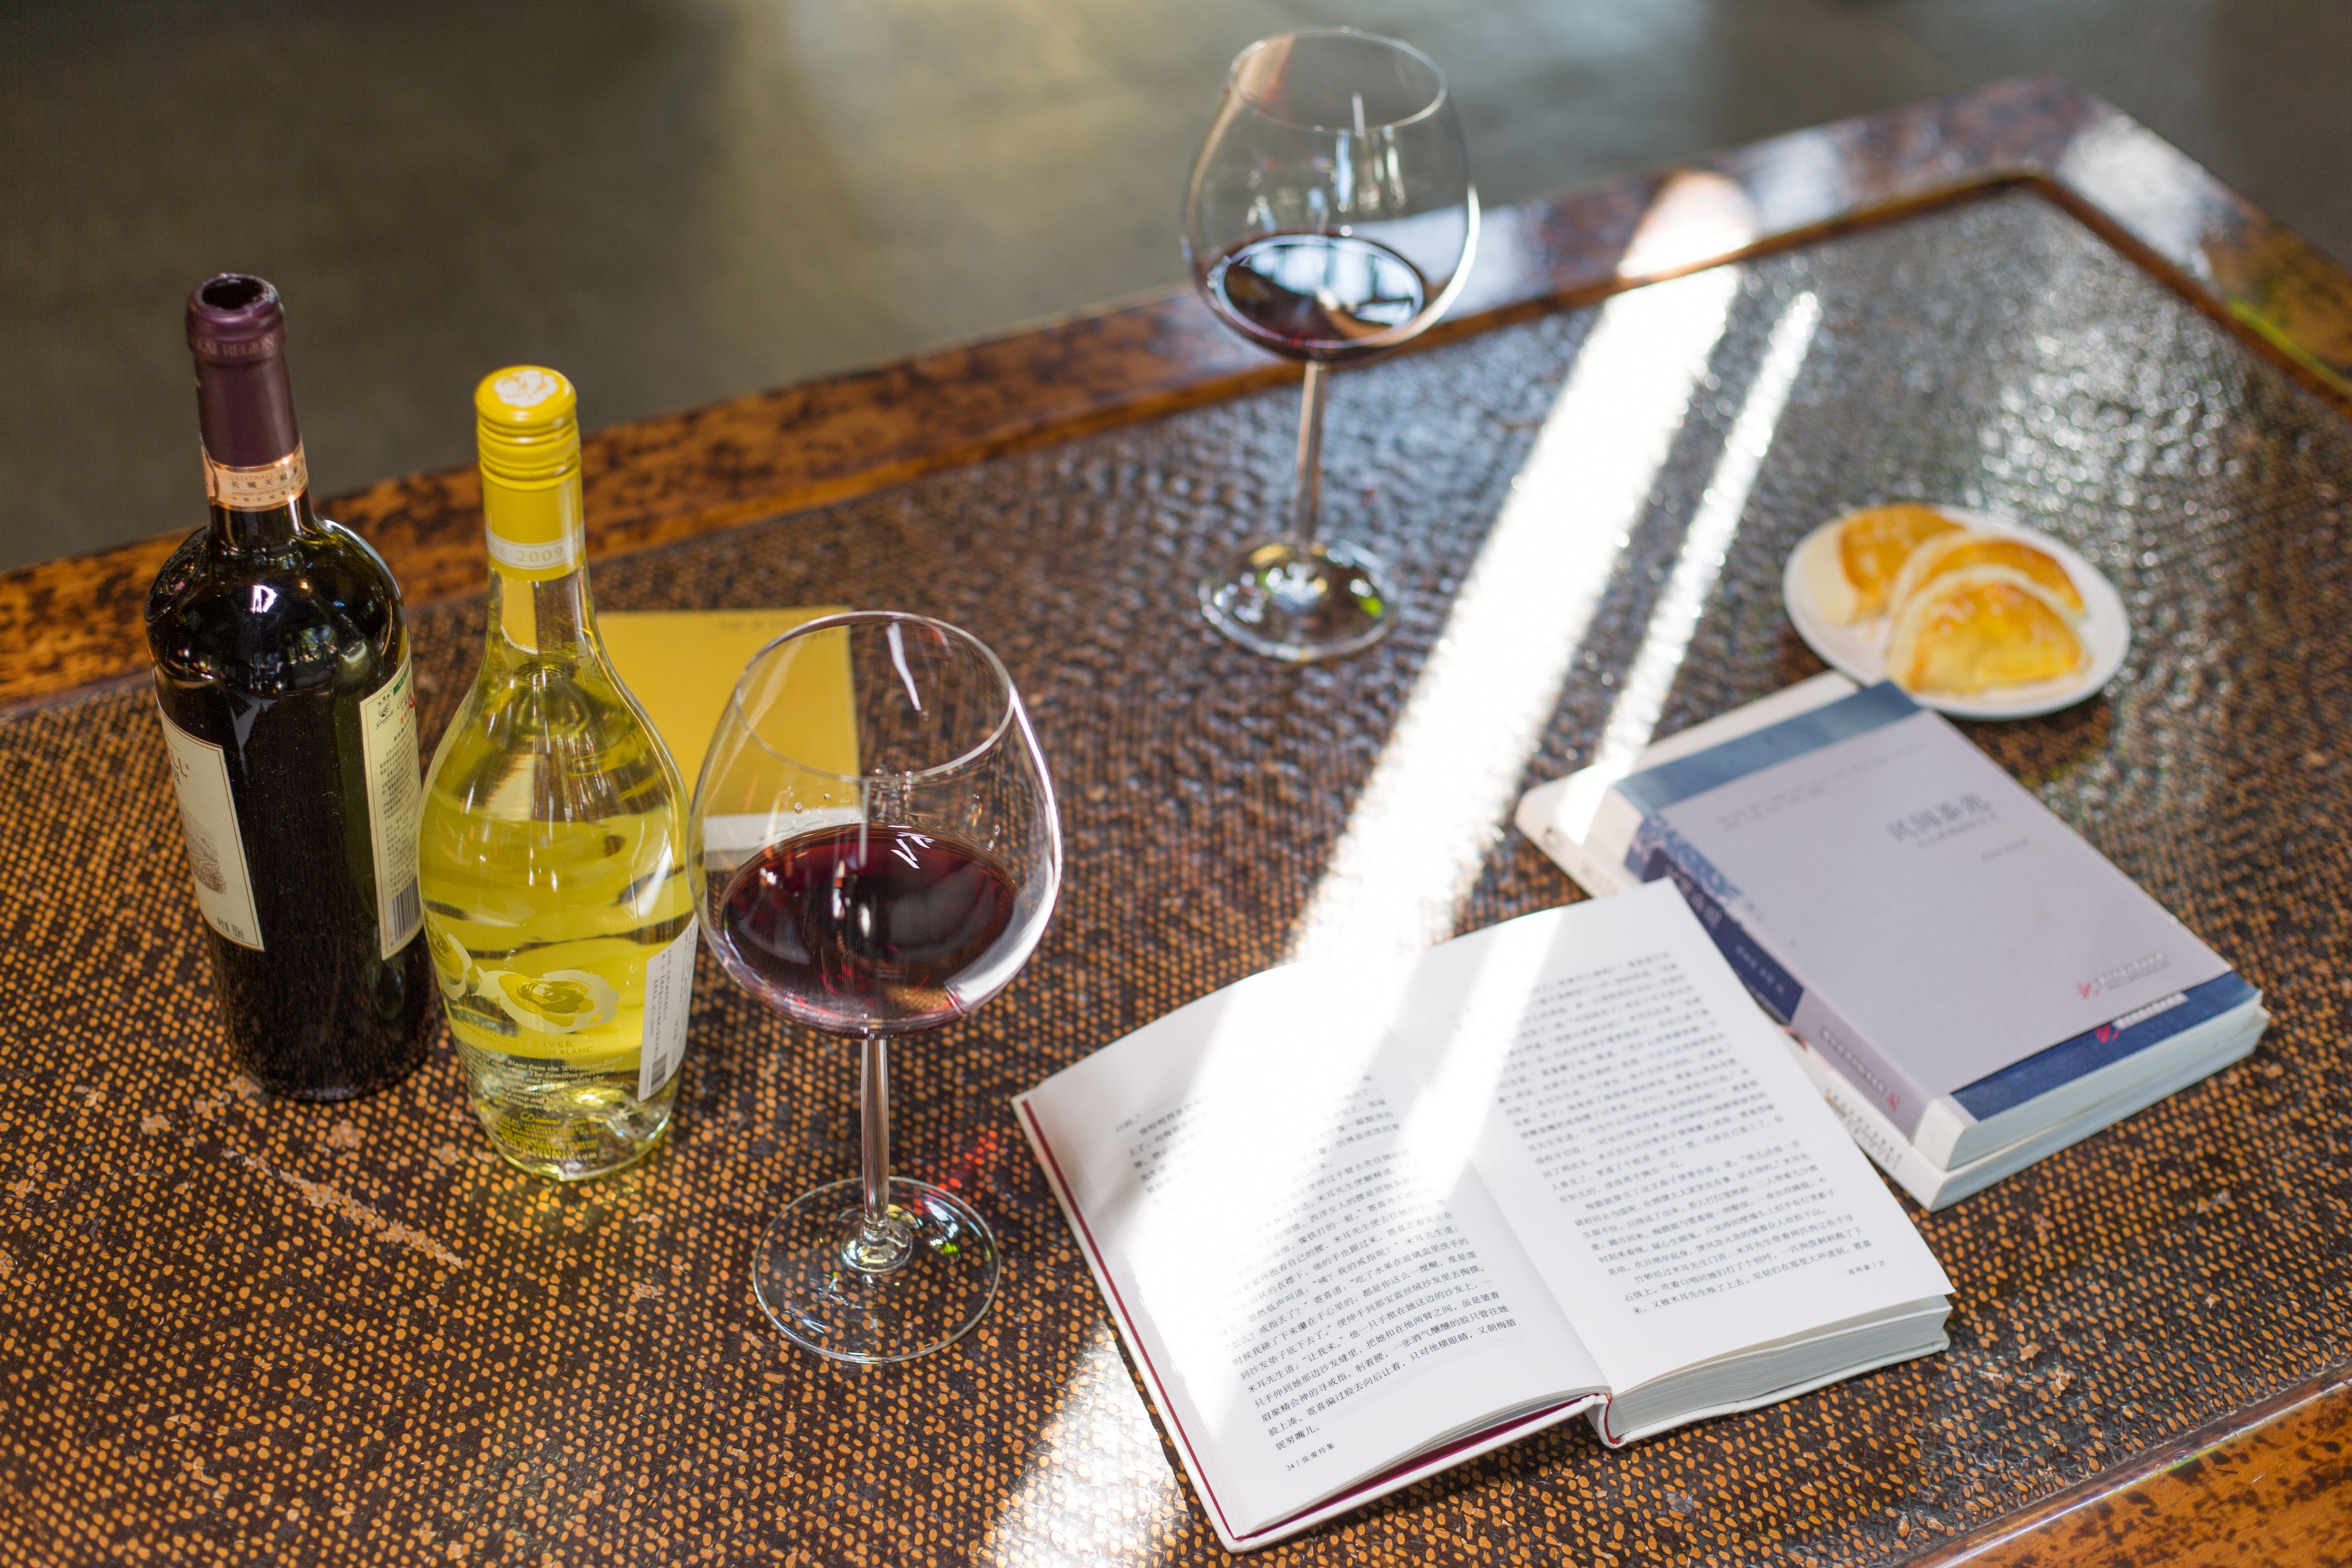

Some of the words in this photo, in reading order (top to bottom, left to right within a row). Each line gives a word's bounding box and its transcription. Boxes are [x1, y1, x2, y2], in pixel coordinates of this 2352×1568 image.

[518, 546, 563, 562] 2009
[559, 1046, 594, 1055] BLANC
[507, 1058, 527, 1069] Blanc
[529, 1063, 546, 1072] from
[1274, 1420, 1321, 1453] 妮努嘴儿。
[1286, 1463, 1295, 1471] 24
[1302, 1441, 1335, 1464] 张爱玲集
